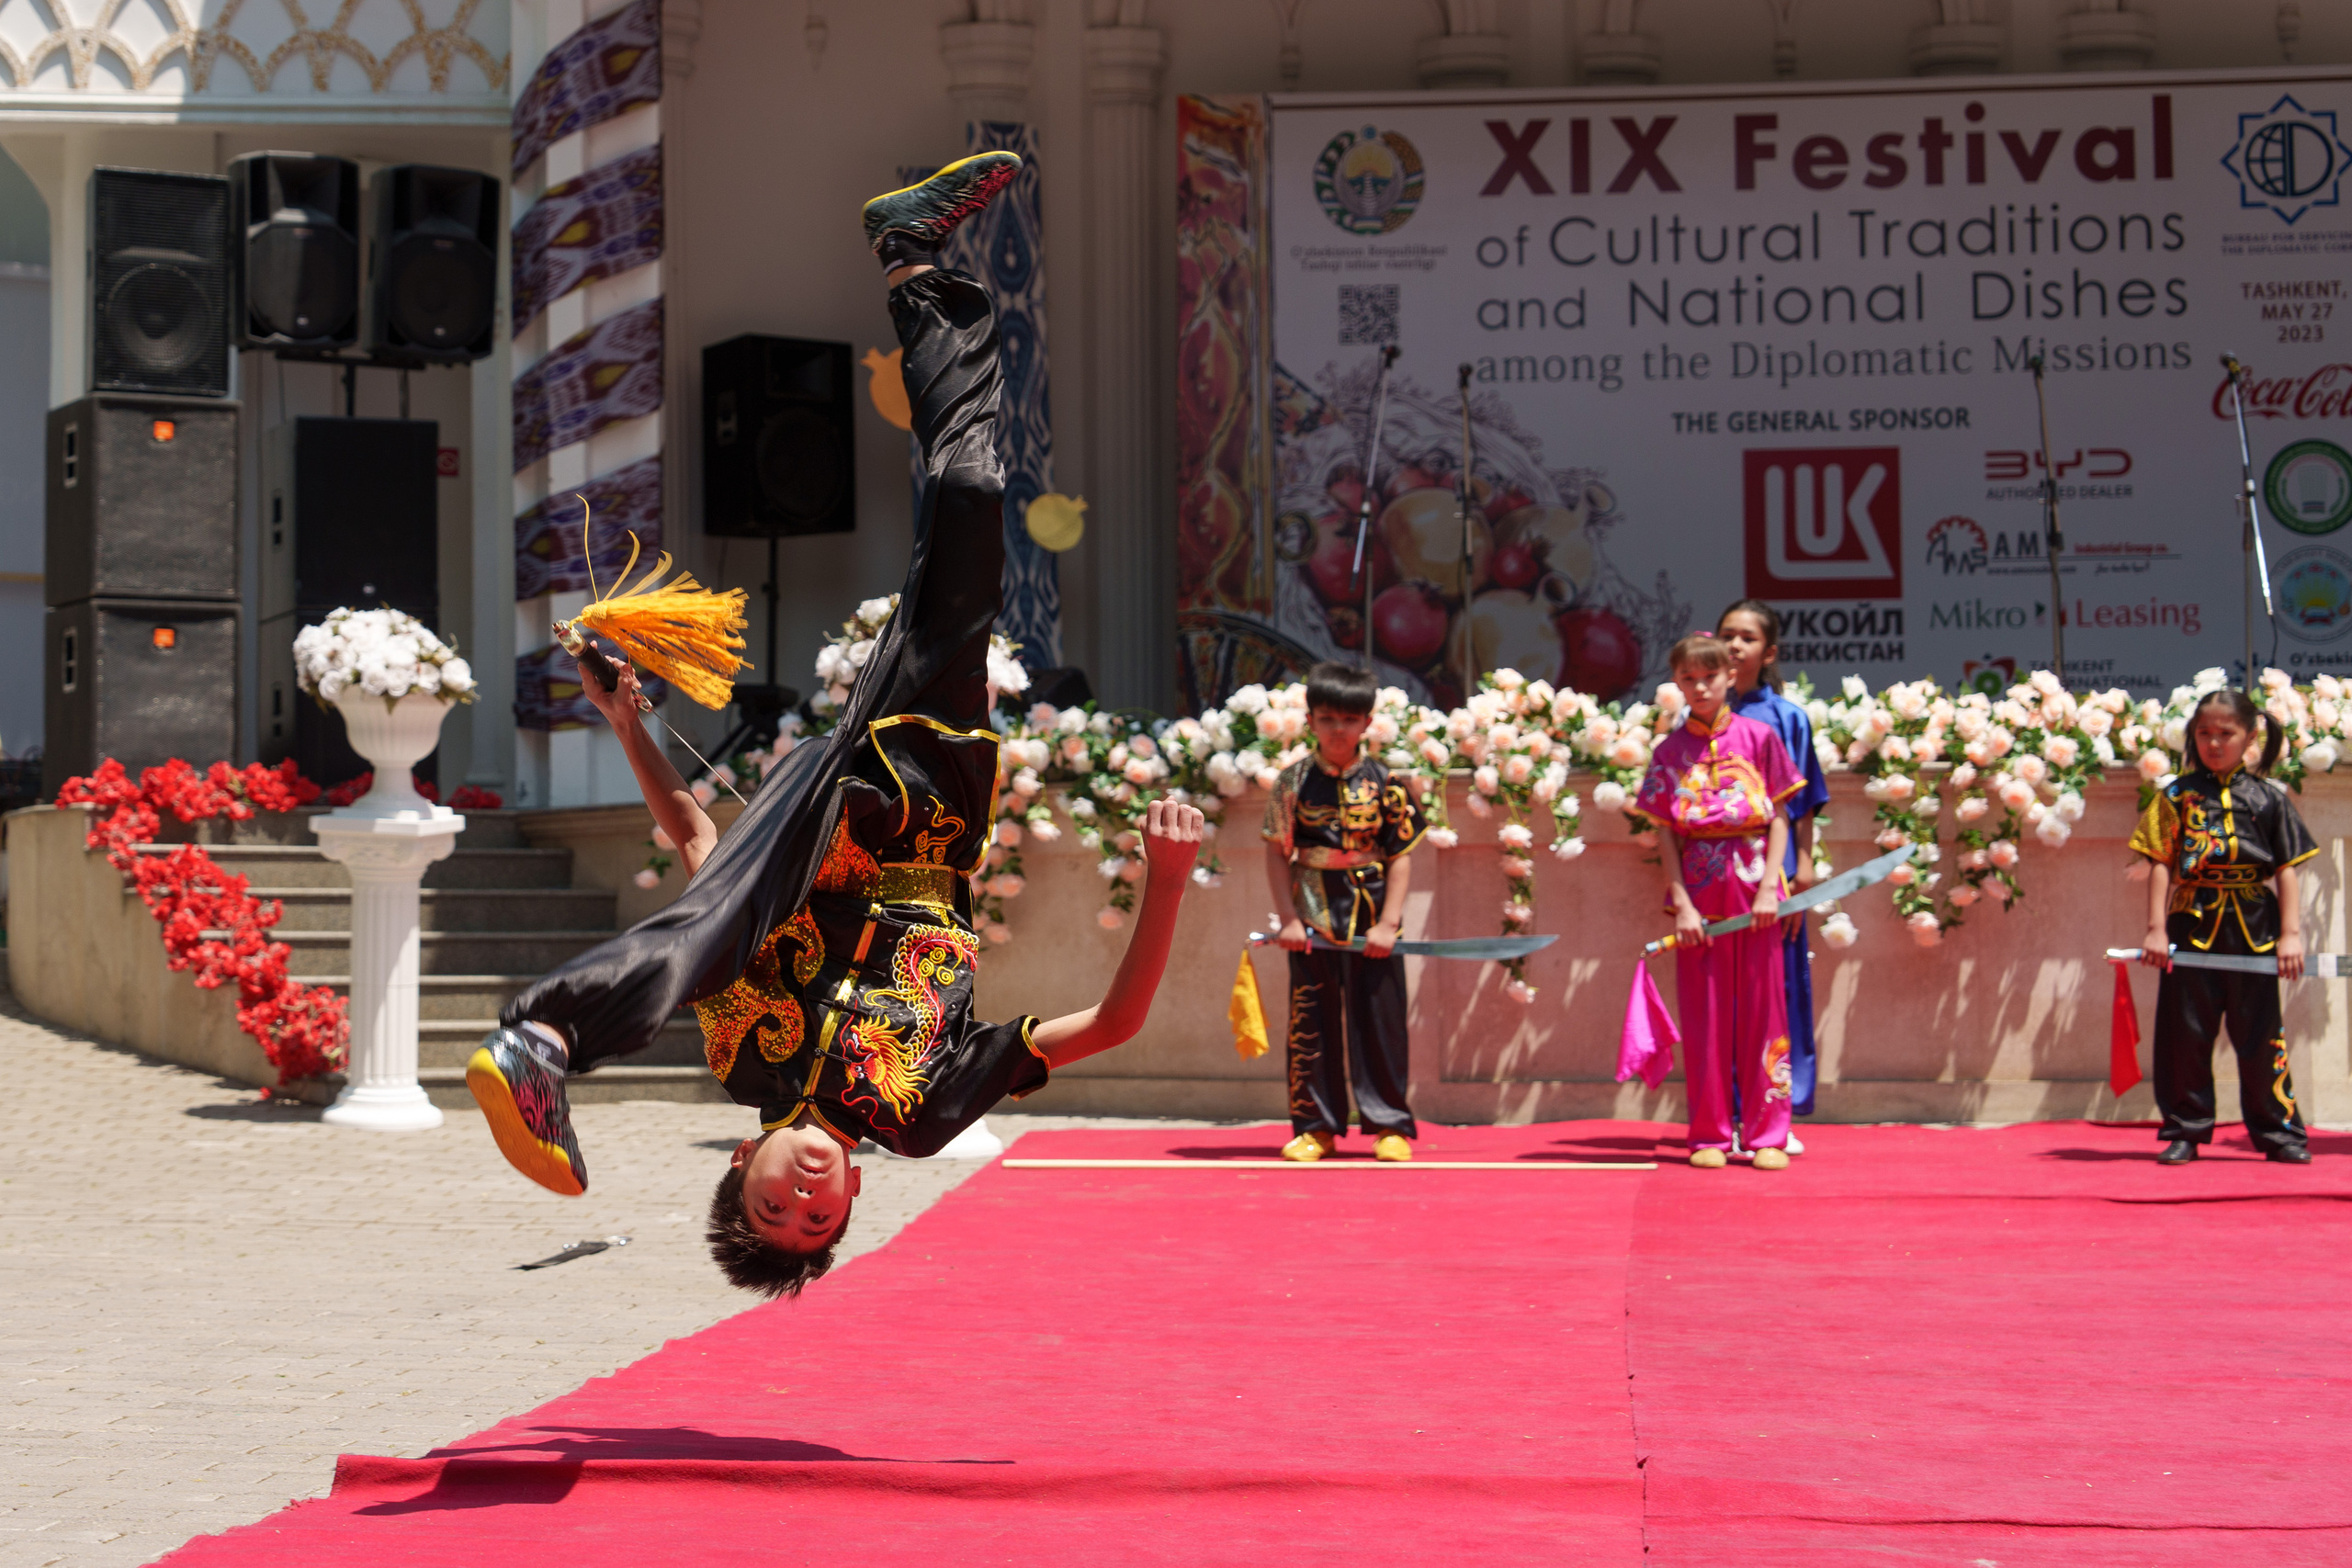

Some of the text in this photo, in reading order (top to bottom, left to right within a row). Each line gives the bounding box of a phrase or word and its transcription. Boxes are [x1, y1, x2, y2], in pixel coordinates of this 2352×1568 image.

[1478, 95, 2174, 197] XIX Festival
[1476, 203, 2185, 268] of Cultural Traditions
[2222, 245, 2245, 255] THE
[1476, 267, 2188, 331] and National Dishes
[2241, 280, 2347, 300] TASHKENT,
[2261, 302, 2334, 321] MAY 27
[2278, 324, 2324, 344] 2023
[1475, 335, 2192, 392] among the Diplomatic Missions
[1672, 407, 1971, 433] THE GENERAL SPONSOR
[1986, 483, 2132, 501] AUTHORED DEALER
[1778, 603, 1903, 636] УКОЙЛ
[1930, 597, 2201, 636] Mikro Leasing
[1780, 642, 1905, 662] БЕКИСТАН
[2061, 674, 2165, 688] RNATIONAL
